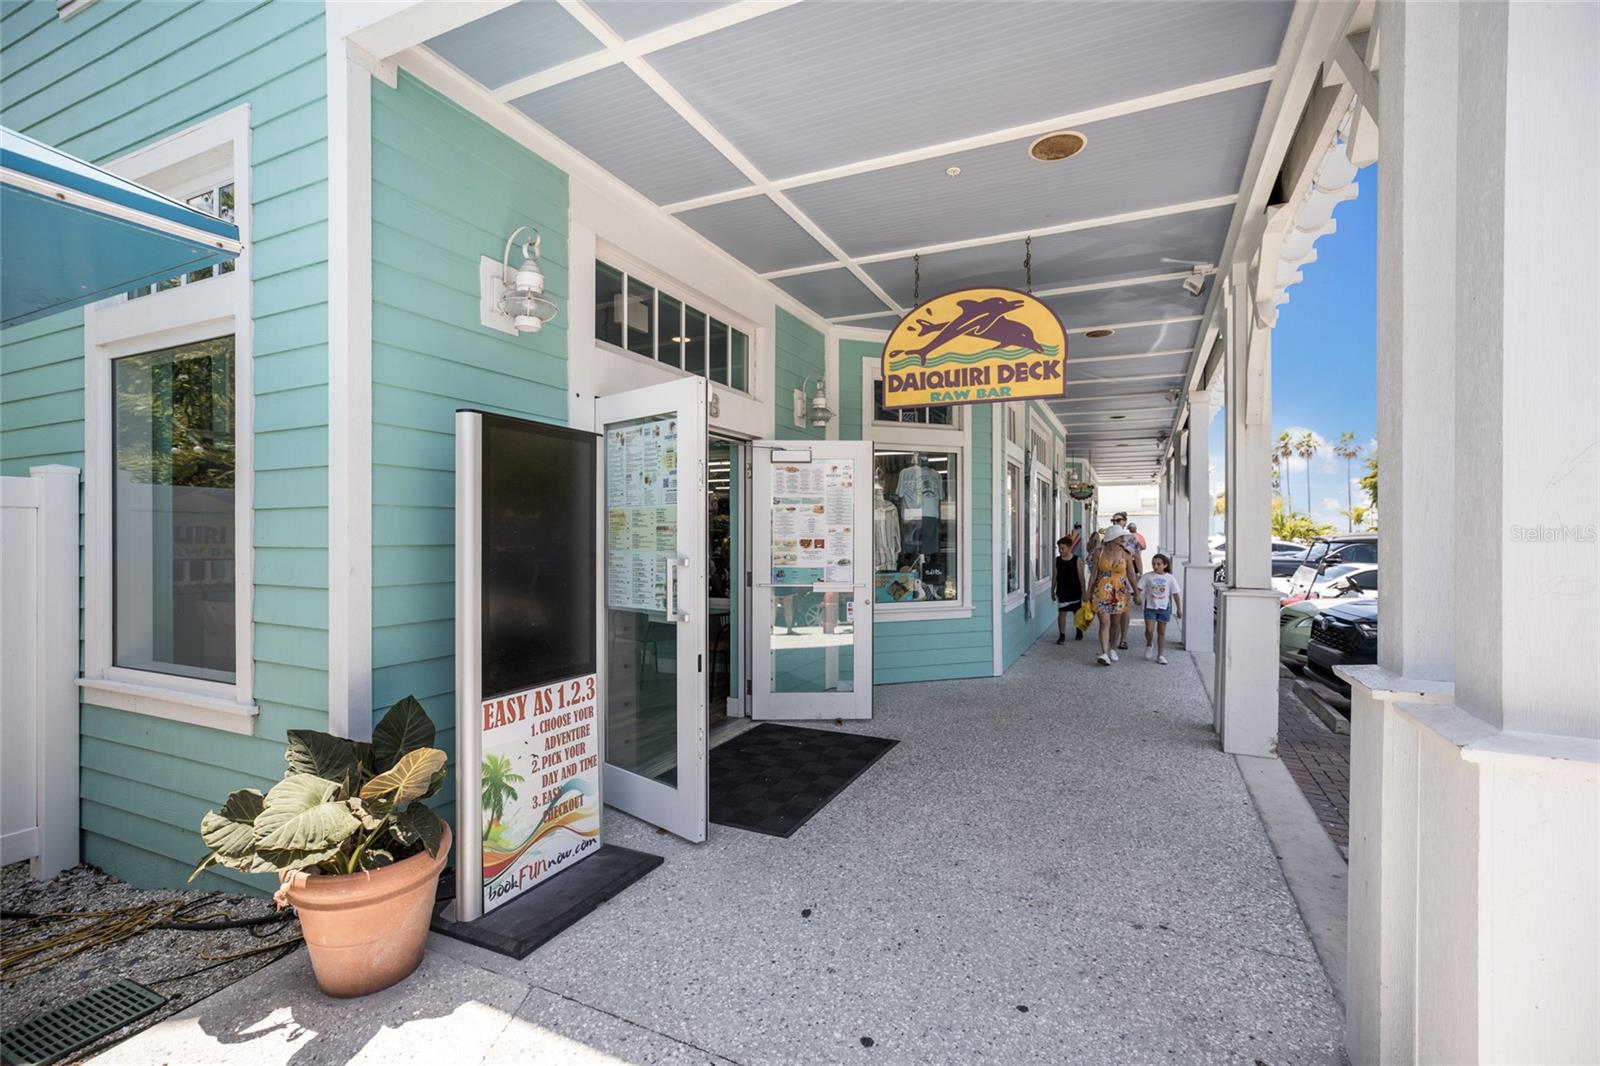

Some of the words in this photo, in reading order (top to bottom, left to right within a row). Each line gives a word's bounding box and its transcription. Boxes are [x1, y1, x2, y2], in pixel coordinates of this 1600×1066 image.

[888, 366, 990, 393] DAIQUIRI
[997, 360, 1061, 384] DECK
[930, 389, 971, 402] RAW
[976, 386, 1012, 398] BAR
[483, 694, 528, 731] EASY
[533, 687, 553, 716] AS
[557, 677, 596, 709] 1.2.3
[531, 723, 539, 737] 1.
[539, 712, 571, 734] CHOOSE
[573, 705, 594, 722] YOUR
[544, 723, 591, 751] ADVENTURE
[531, 760, 541, 774] 2.
[541, 751, 562, 769] PICK
[564, 741, 586, 760] YOUR
[541, 769, 560, 788] DAY
[560, 763, 577, 780] AND
[578, 754, 598, 773] TIME
[532, 795, 541, 809] 3.
[542, 785, 563, 806] EASY
[542, 792, 585, 823] CHECKOUT
